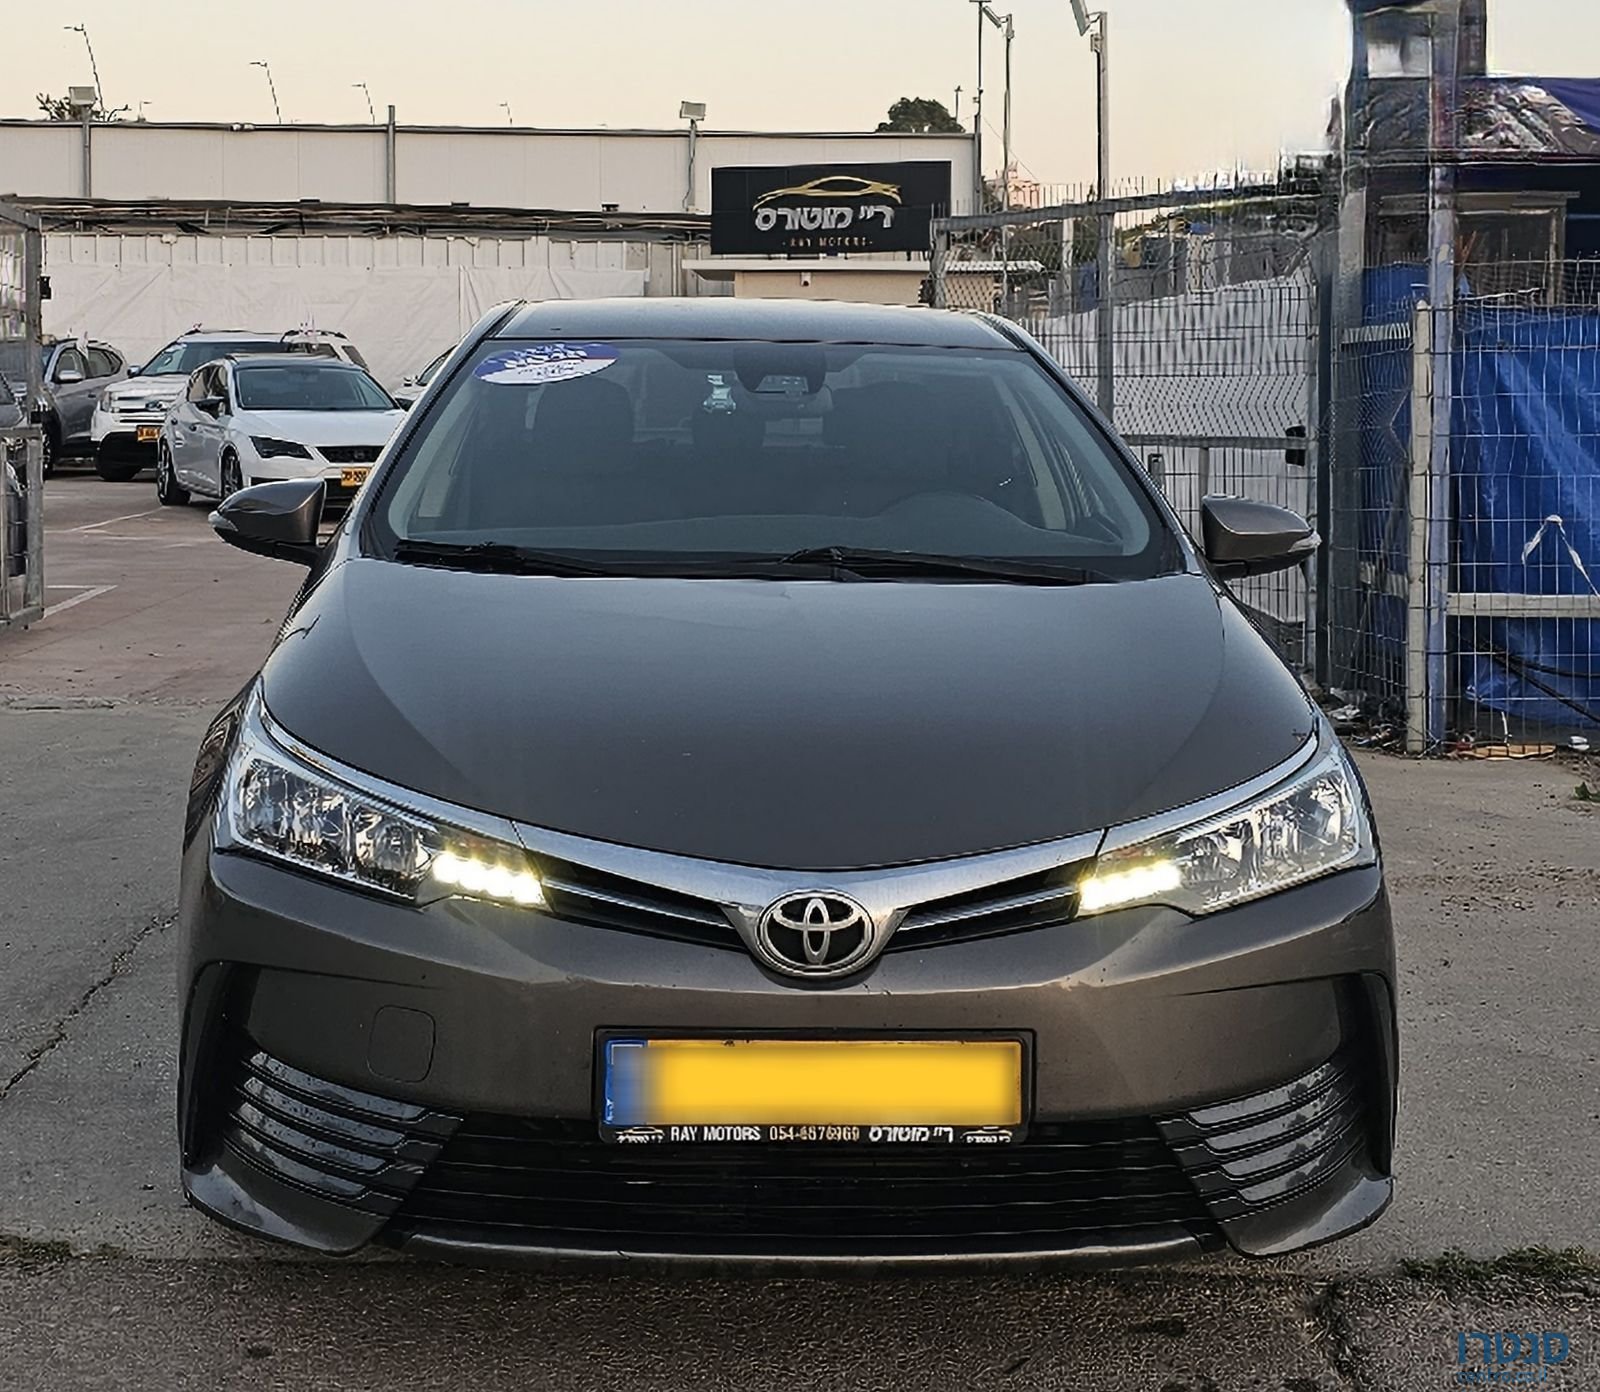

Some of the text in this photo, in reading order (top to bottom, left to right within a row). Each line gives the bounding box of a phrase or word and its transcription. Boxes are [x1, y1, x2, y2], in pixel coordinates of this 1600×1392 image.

[755, 207, 852, 231] מוטורס
[669, 1126, 698, 1142] RAY
[703, 1126, 762, 1142] MOTORS
[868, 1126, 931, 1142] מוטורס
